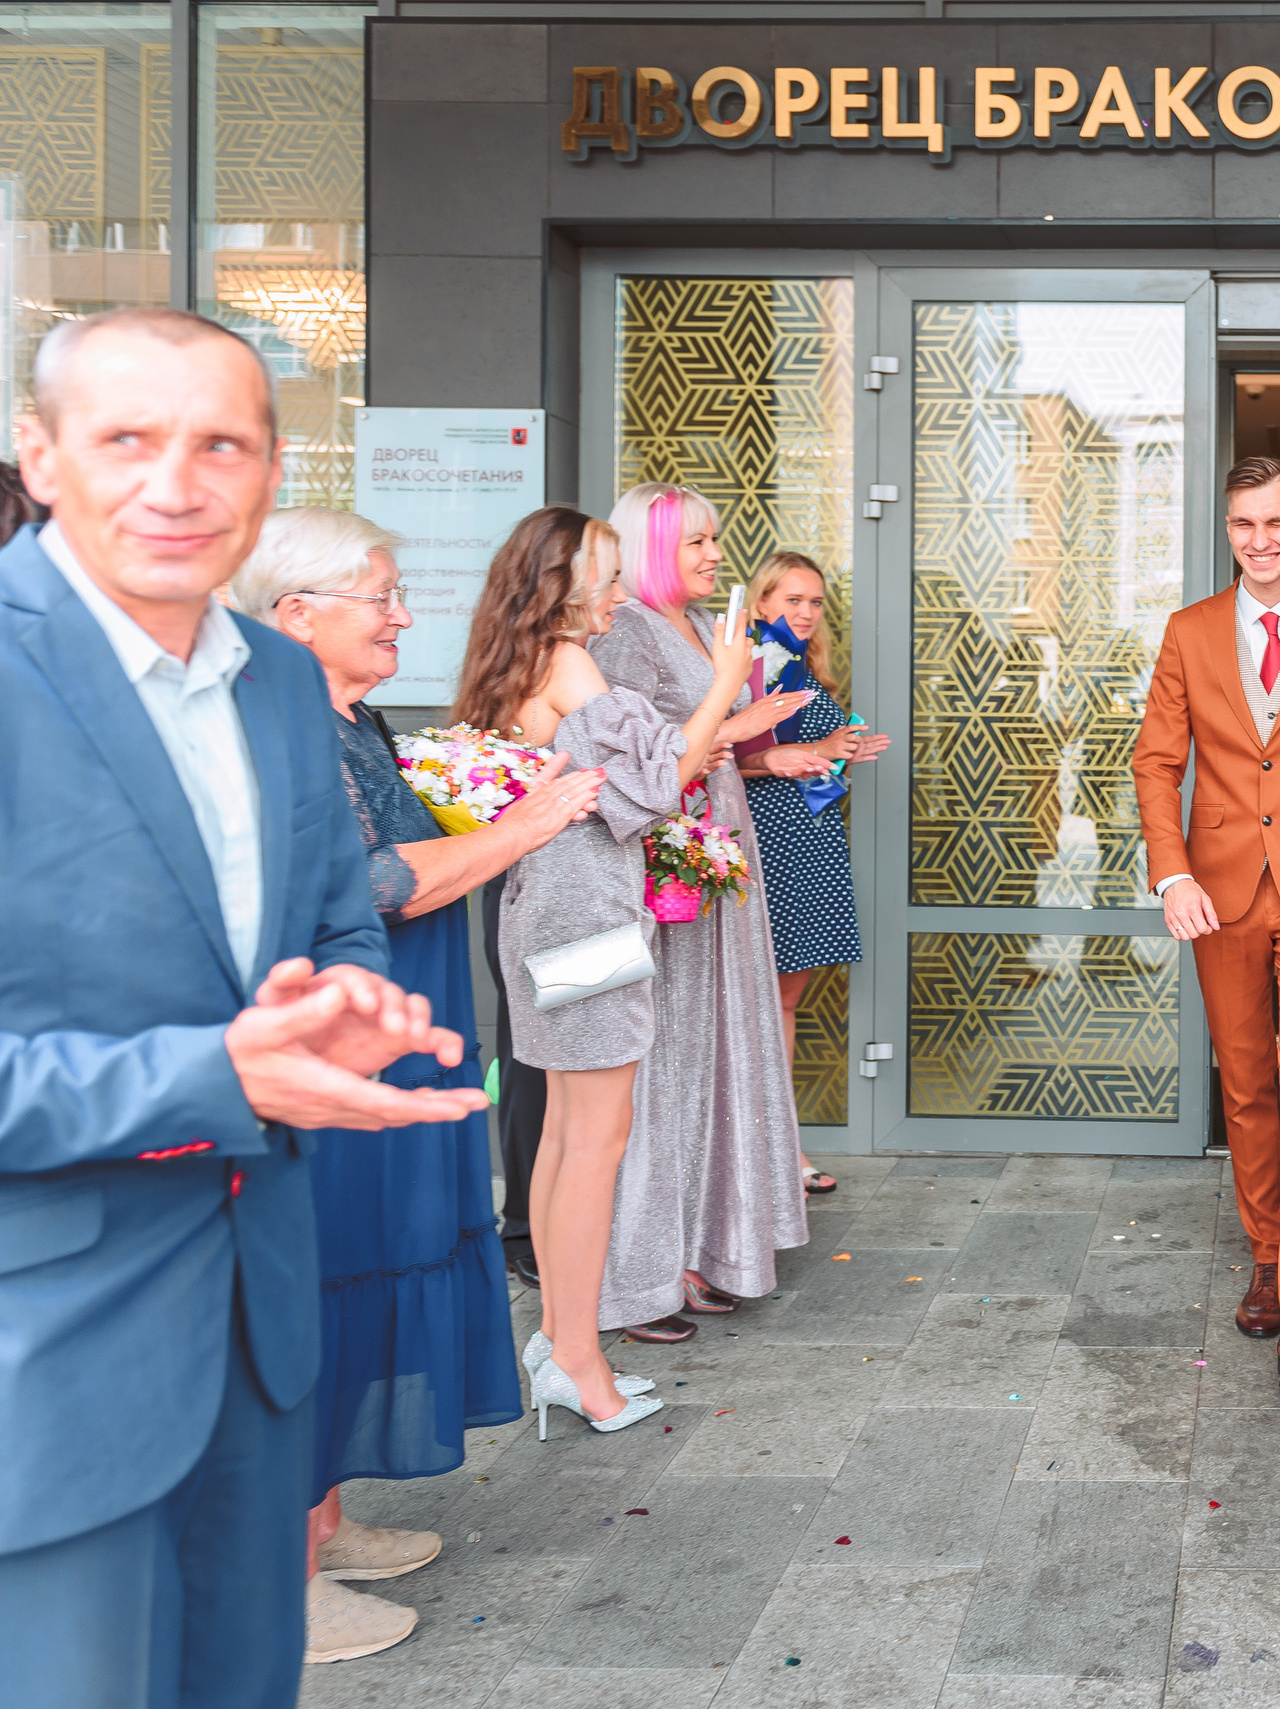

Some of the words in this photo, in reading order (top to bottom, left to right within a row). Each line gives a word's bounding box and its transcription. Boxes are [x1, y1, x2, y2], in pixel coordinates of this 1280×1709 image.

[561, 63, 945, 153] ДВОРЕЦ
[371, 448, 439, 464] ДВОРЕЦ
[371, 468, 524, 483] БРАКОСОЧЕТАНИЯ
